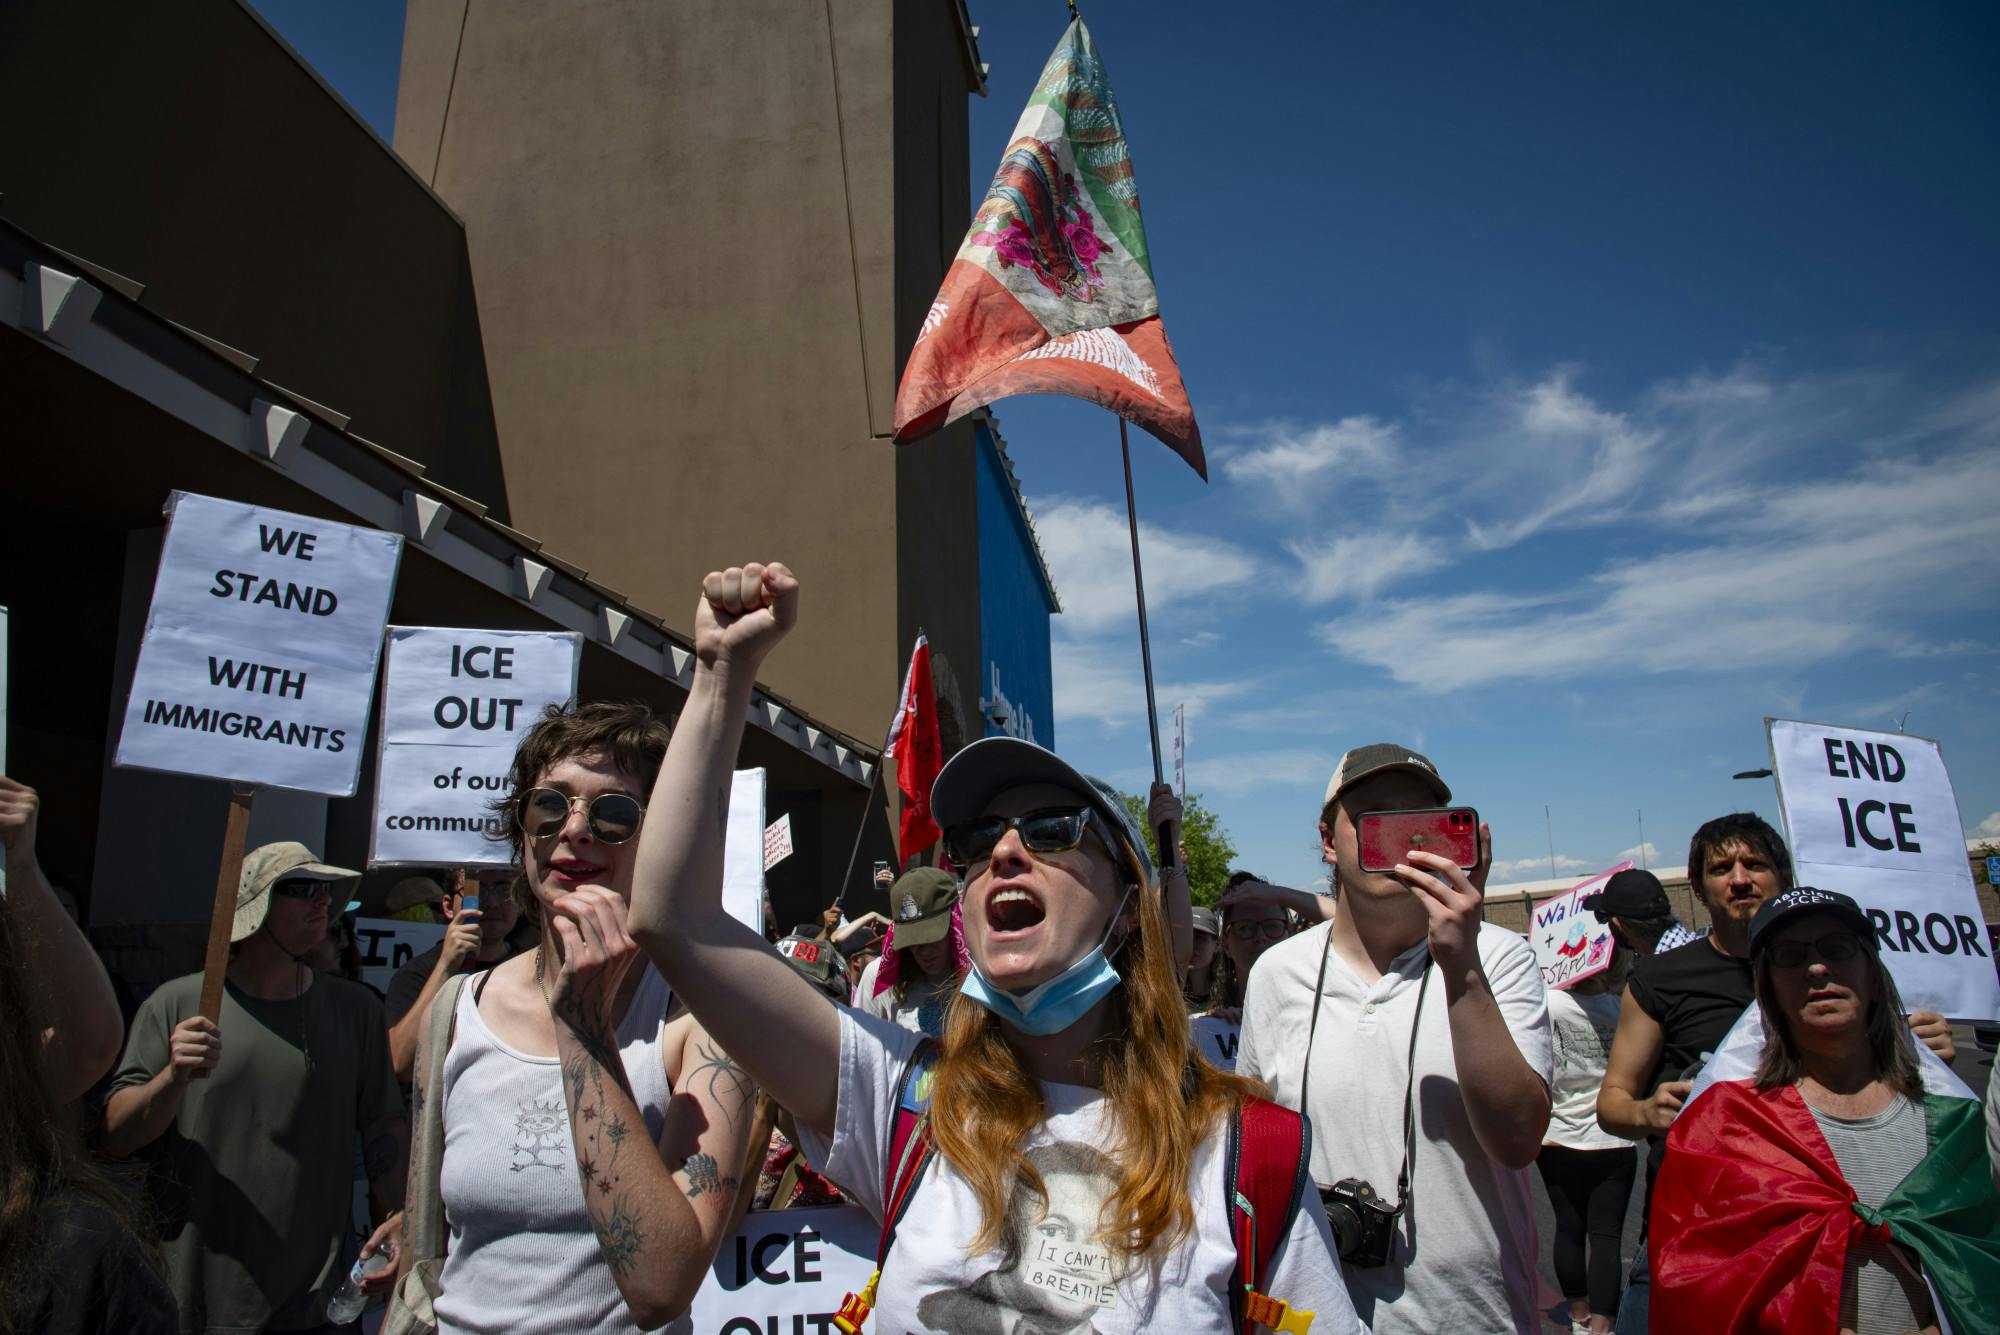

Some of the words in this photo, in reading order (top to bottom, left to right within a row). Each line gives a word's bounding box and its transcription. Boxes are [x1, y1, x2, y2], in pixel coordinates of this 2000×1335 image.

[259, 523, 318, 562] WE
[209, 568, 339, 617] STAND
[207, 655, 308, 700] WITH
[450, 645, 515, 680] ICE
[143, 699, 347, 753] IMMIGRANTS
[433, 695, 524, 732] OUT
[433, 766, 463, 789] of
[467, 775, 510, 791] our
[1823, 737, 1906, 783] END
[385, 814, 502, 833] commun
[1837, 797, 1922, 854] ICE
[1772, 889, 1835, 907] ABOLISH
[1787, 895, 1822, 908] ICE
[1866, 908, 1988, 958] RROR
[1334, 1187, 1354, 1197] Canon
[735, 1231, 822, 1287] ICE
[1046, 1247, 1058, 1262] I
[1064, 1250, 1110, 1271] CAN'T
[1032, 1271, 1116, 1304] BREATHE
